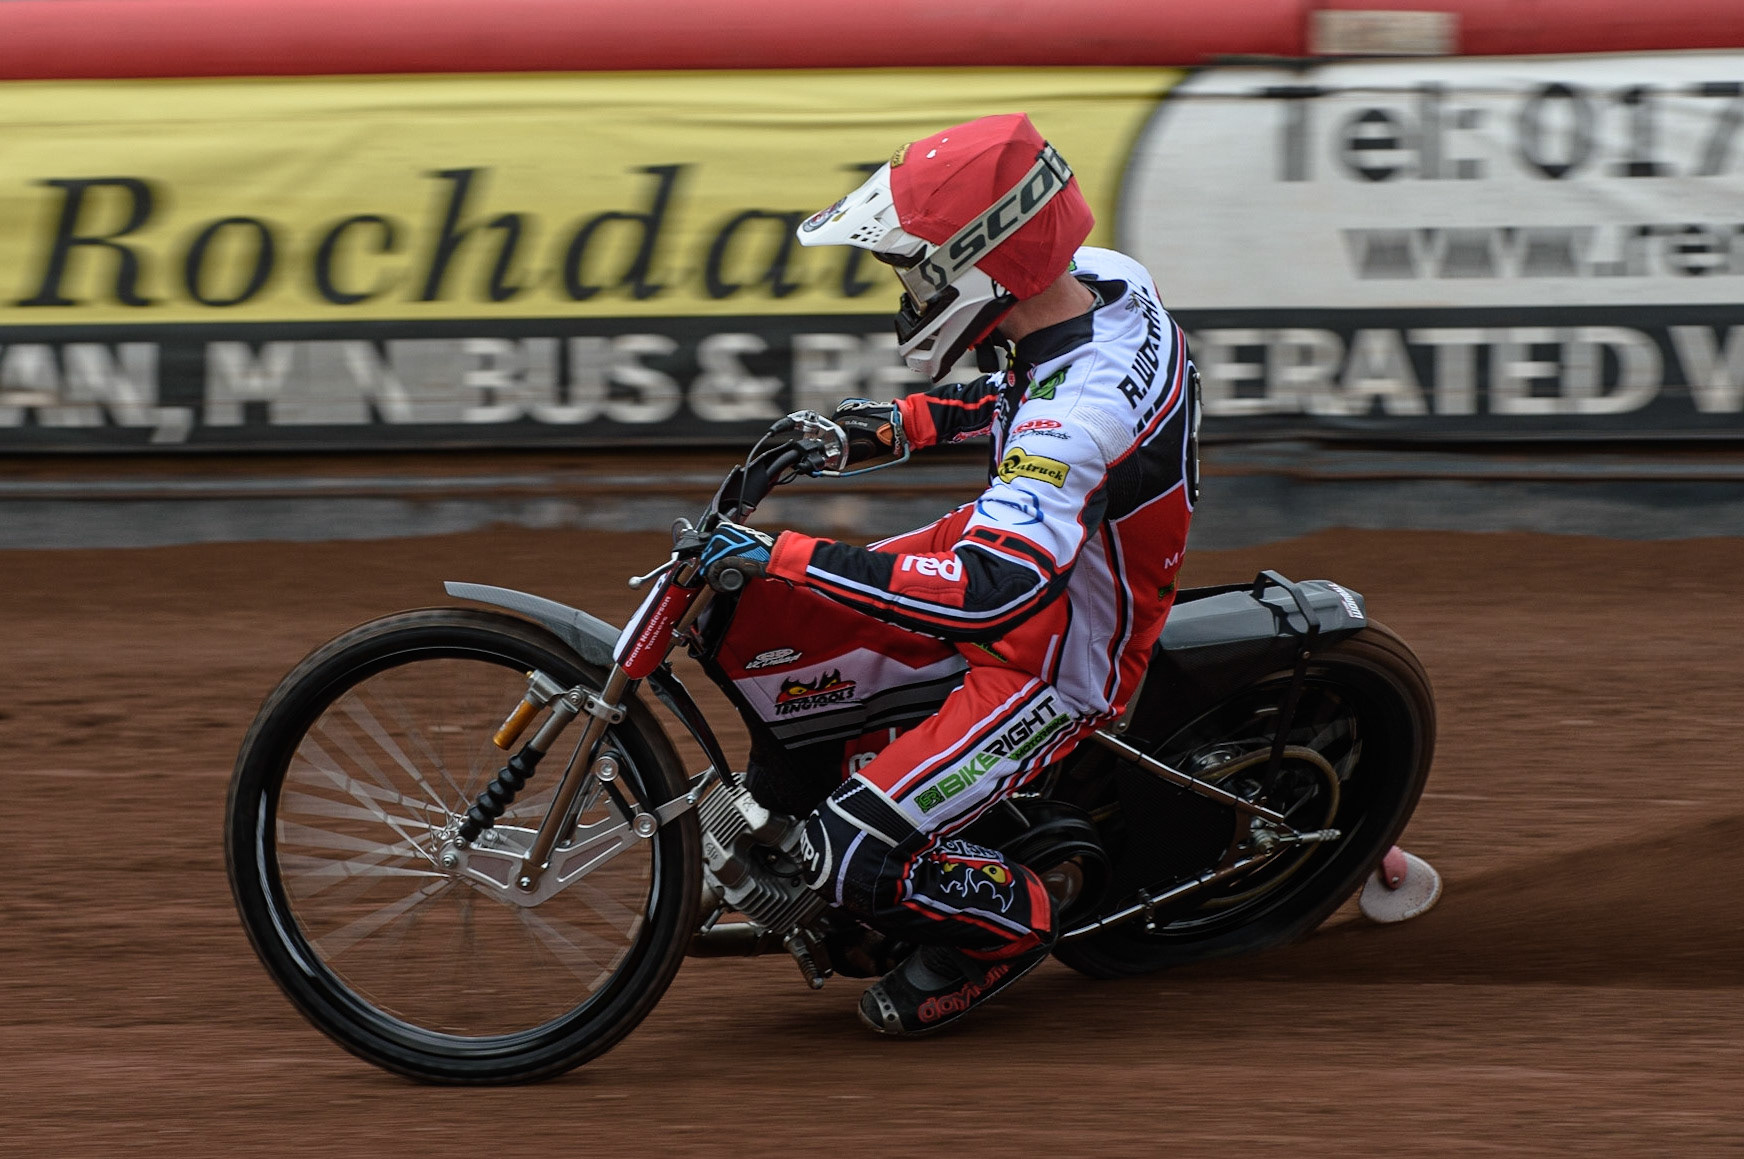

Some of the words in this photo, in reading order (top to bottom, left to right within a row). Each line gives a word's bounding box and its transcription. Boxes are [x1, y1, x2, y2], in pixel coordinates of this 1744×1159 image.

[1340, 224, 1744, 278] www.re
[901, 553, 963, 582] red
[624, 641, 643, 668] Grant
[640, 596, 672, 643] Henderson
[644, 616, 668, 650] Tankers
